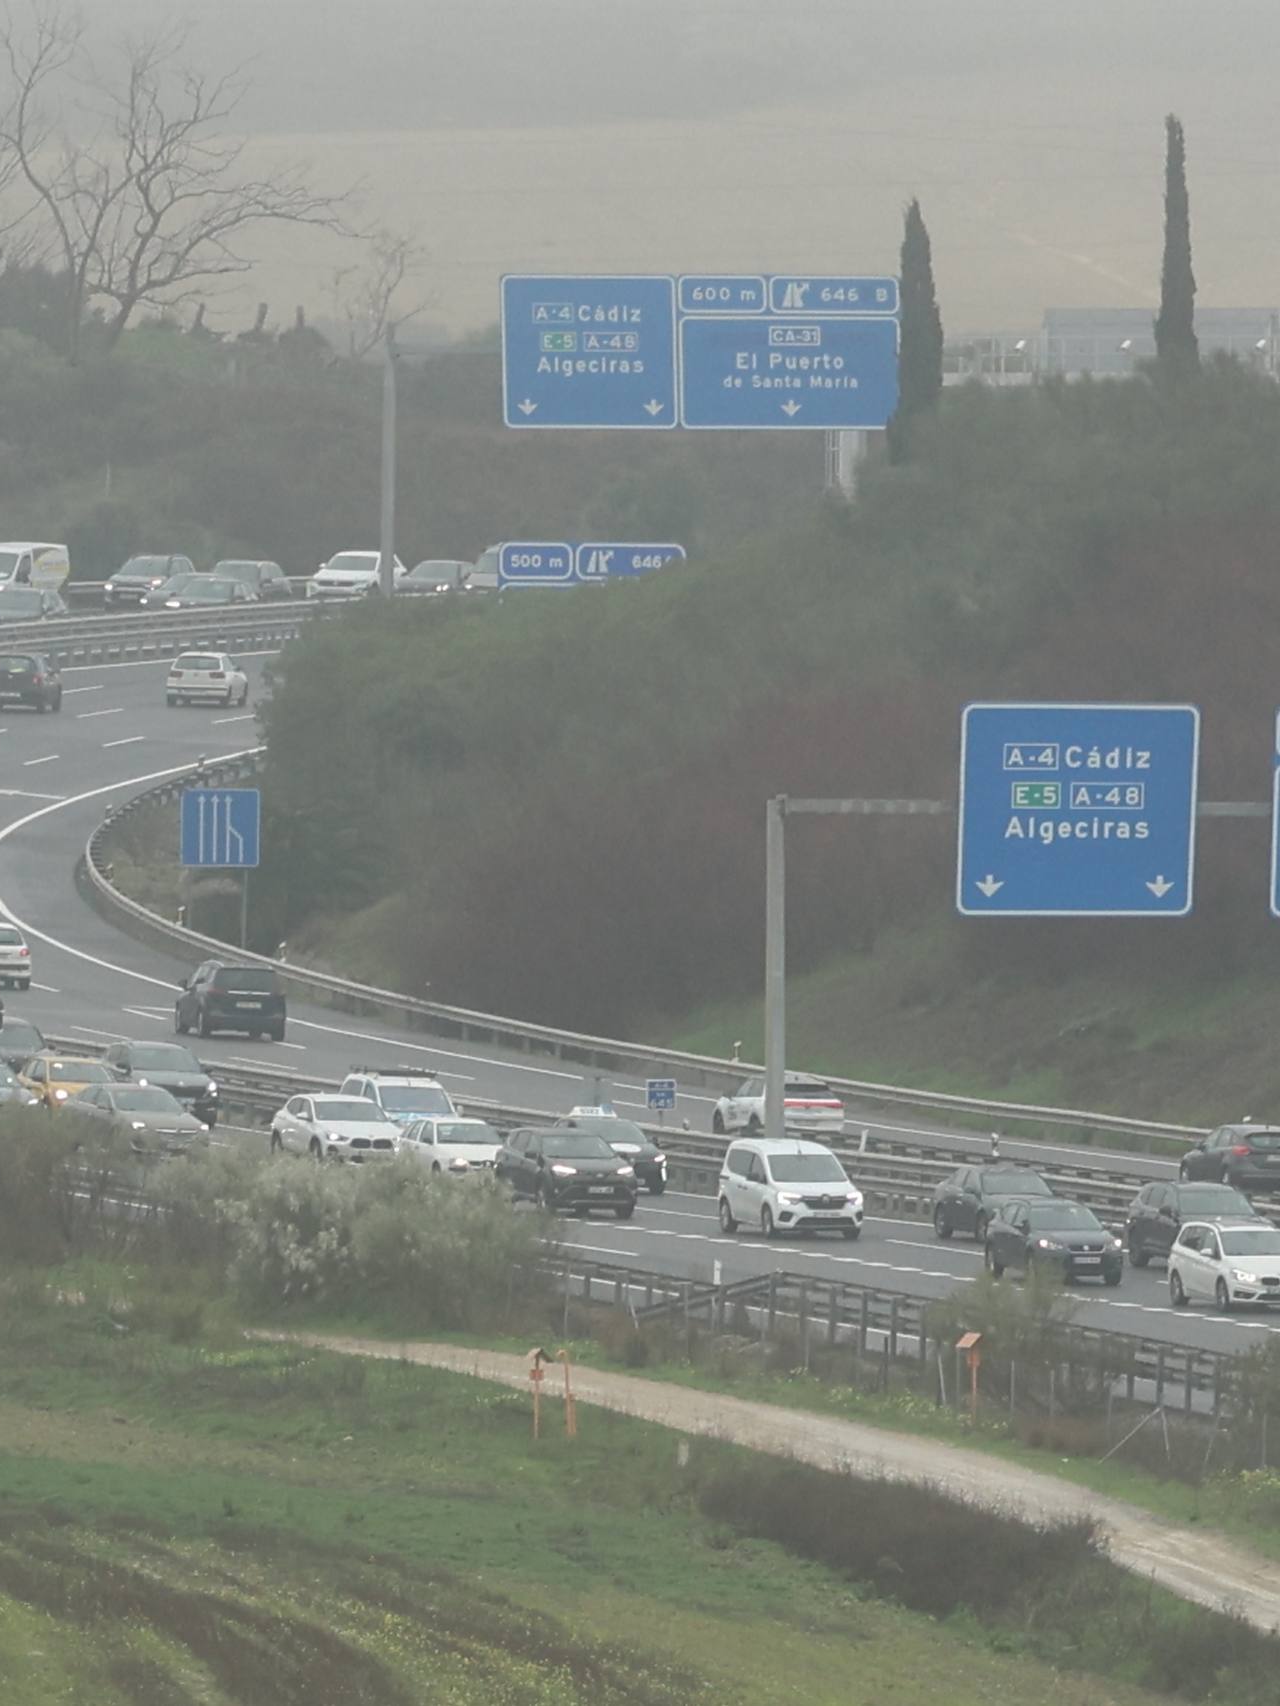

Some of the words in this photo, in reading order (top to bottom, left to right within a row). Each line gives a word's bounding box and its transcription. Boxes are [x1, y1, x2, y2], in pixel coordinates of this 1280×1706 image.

[692, 287, 730, 300] 600
[740, 289, 756, 300] m
[820, 288, 859, 301] 646
[875, 288, 888, 302] B
[535, 306, 570, 320] A-4
[578, 304, 641, 322] Cádiz
[543, 334, 574, 348] E-5
[587, 334, 635, 348] A-48
[772, 330, 818, 342] CA-31
[536, 356, 644, 377] Algeciras
[736, 352, 757, 370] El
[769, 352, 844, 370] Puerto
[723, 374, 742, 388] de
[752, 374, 801, 388] Santa
[510, 554, 542, 568] 500
[548, 556, 563, 568] m
[1007, 747, 1054, 766] A-4
[1065, 745, 1151, 769] Cádiz
[1015, 786, 1057, 805] E-5
[1074, 786, 1140, 805] A-48
[1004, 815, 1150, 845] Algeciras
